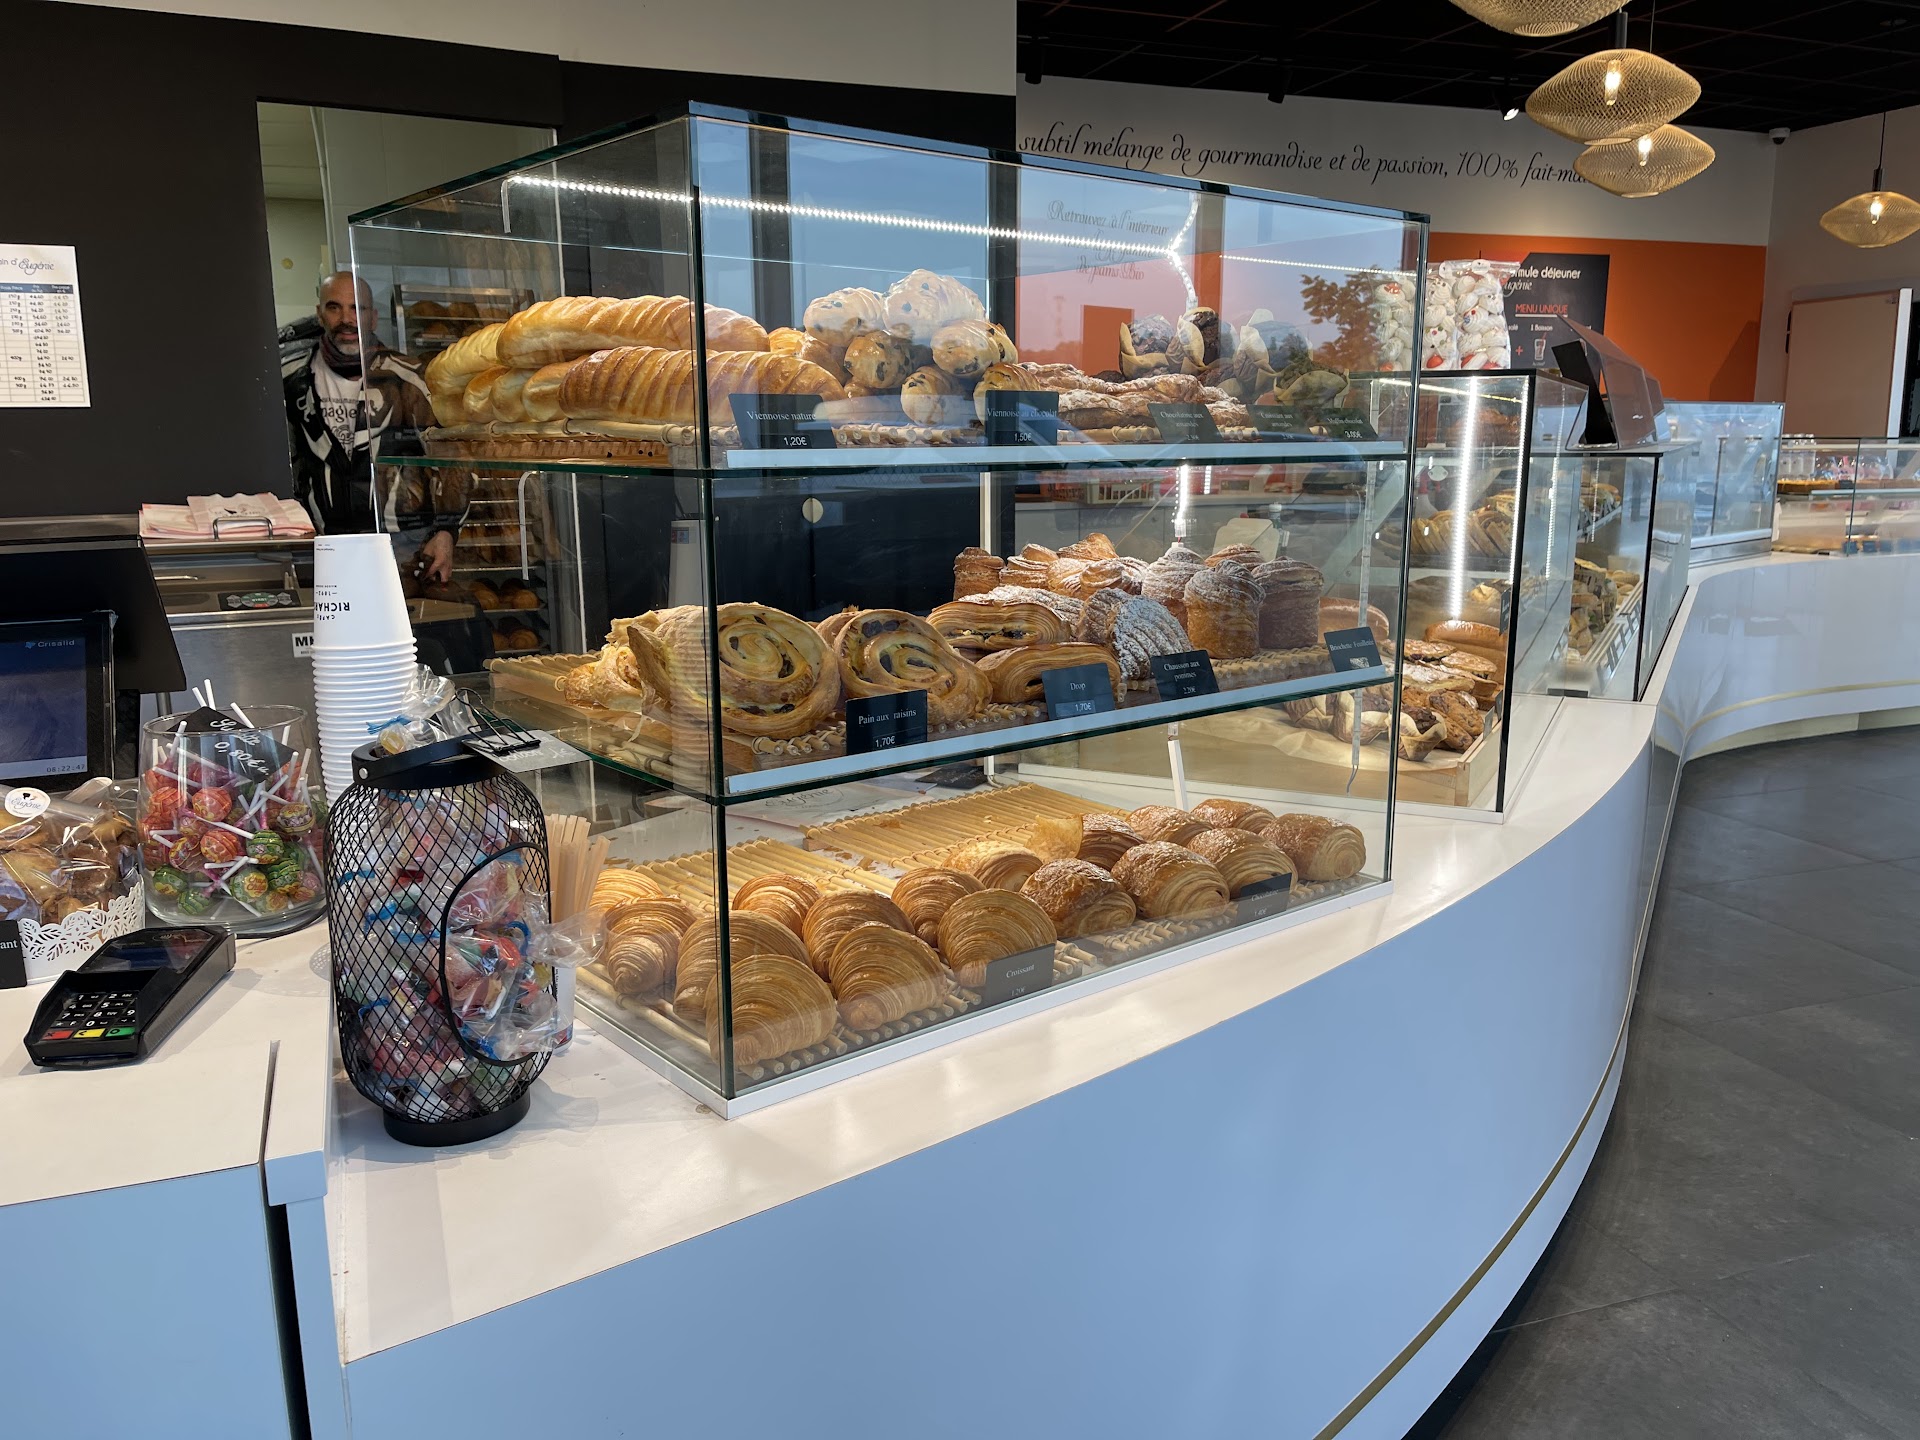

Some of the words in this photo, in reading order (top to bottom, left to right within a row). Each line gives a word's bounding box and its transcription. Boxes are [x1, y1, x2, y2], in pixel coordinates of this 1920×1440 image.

[1019, 121, 1092, 154] subtil
[1083, 127, 1164, 171] mélange
[1171, 134, 1192, 161] de
[1181, 141, 1322, 177] gourmandise
[1329, 153, 1347, 171] et
[1351, 144, 1371, 172] de
[1456, 151, 1519, 179] 100%
[1371, 156, 1448, 185] passion,
[1520, 152, 1589, 188] fait-ma
[1510, 266, 1539, 279] ormule
[1541, 266, 1581, 280] déjeuner
[1503, 280, 1533, 298] ugénie
[1515, 304, 1538, 313] MENU
[1539, 304, 1568, 314] UNIQUE
[746, 410, 790, 420] Viennoise
[790, 412, 816, 420] nature
[987, 407, 1020, 418] Viennoise
[1030, 408, 1057, 418] chocolat
[783, 436, 808, 447] 1,20€
[1014, 432, 1033, 443] 1,50€
[37, 639, 75, 648] Crisalid
[1163, 662, 1190, 671] Chausson
[1174, 672, 1197, 682] pommes
[1075, 702, 1092, 712] 1,70€
[858, 714, 875, 725] Pain
[876, 713, 890, 722] aux
[893, 708, 917, 720] raisins
[875, 735, 896, 749] 1,70€
[46, 763, 86, 774] 08:22:47
[0, 940, 18, 949] ant
[1005, 964, 1036, 979] Croissant
